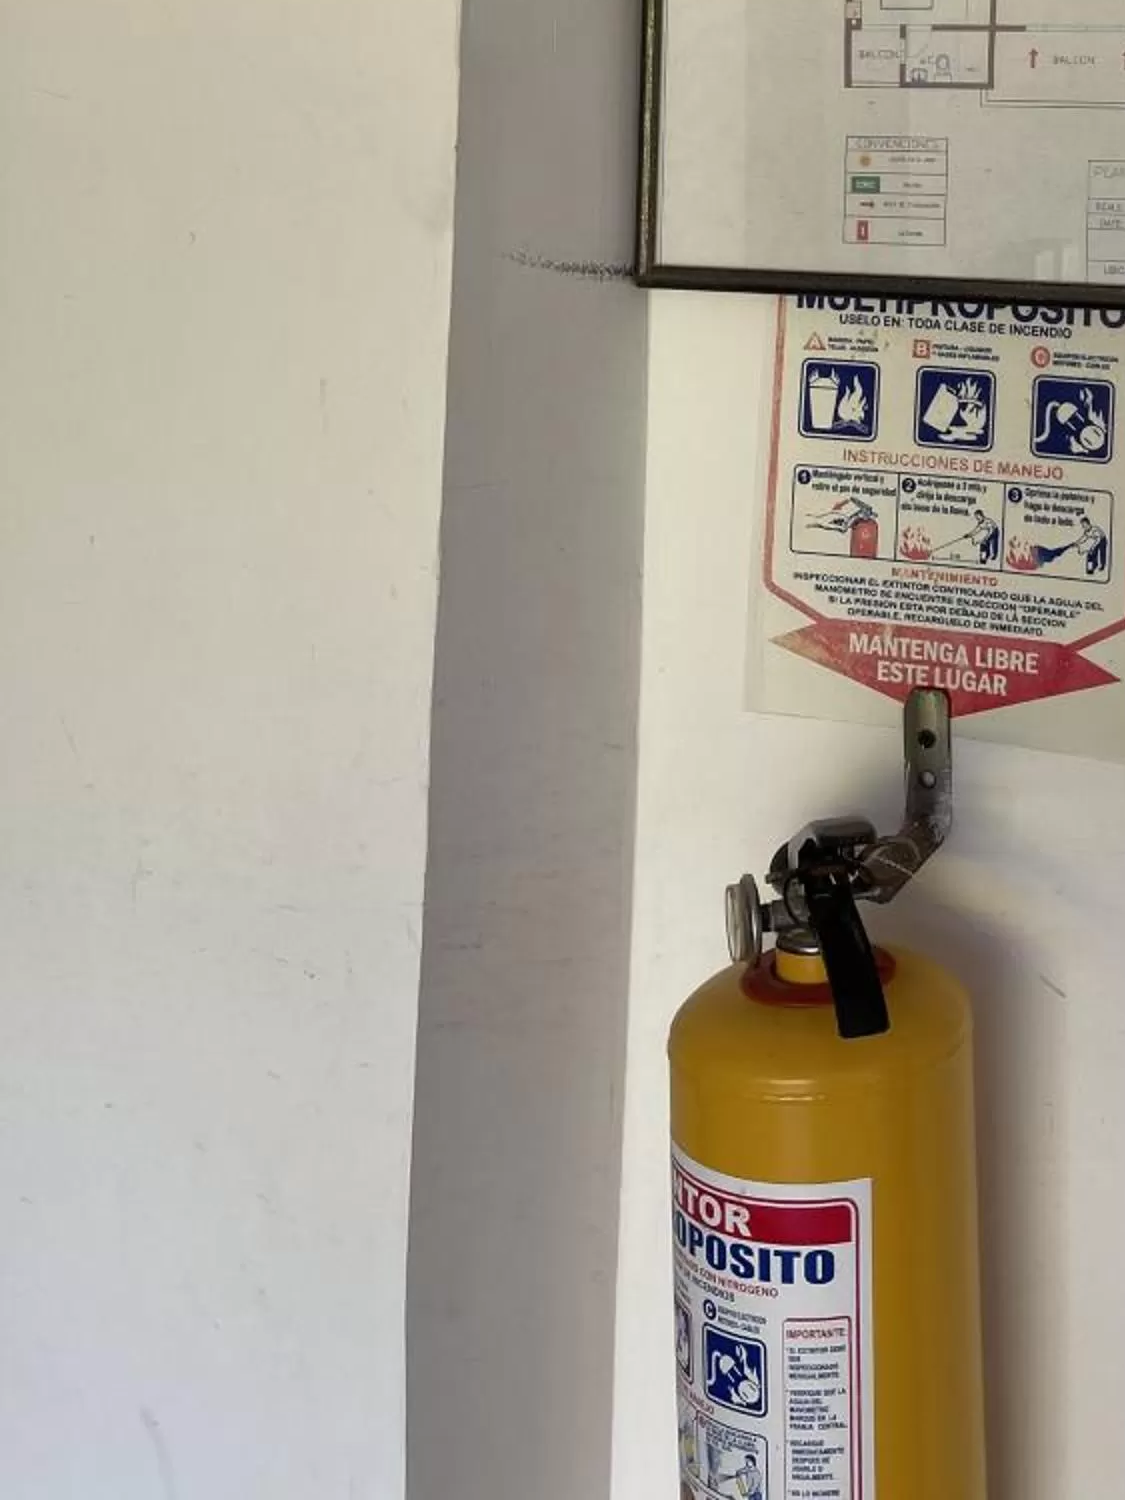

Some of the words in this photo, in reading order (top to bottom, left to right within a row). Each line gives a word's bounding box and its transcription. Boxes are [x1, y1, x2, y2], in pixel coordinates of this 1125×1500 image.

[839, 314, 882, 328] USELO
[908, 317, 942, 332] TODA
[944, 320, 985, 334] CLASE
[990, 323, 1005, 336] DE
[1010, 325, 1073, 341] INCENDIO
[843, 447, 969, 472] INSTRUCCIONES
[973, 456, 992, 473] DE
[998, 460, 1064, 480] MANEJO
[840, 596, 853, 605] LA
[932, 584, 1008, 602] CONTROLANDO
[1034, 595, 1047, 605] LA
[848, 631, 970, 668] MANTENGA
[975, 645, 1041, 675] LIBRE
[877, 658, 930, 687] ESTE
[934, 665, 1008, 697] LUGAR
[786, 1327, 846, 1340] IMPORTANTE
